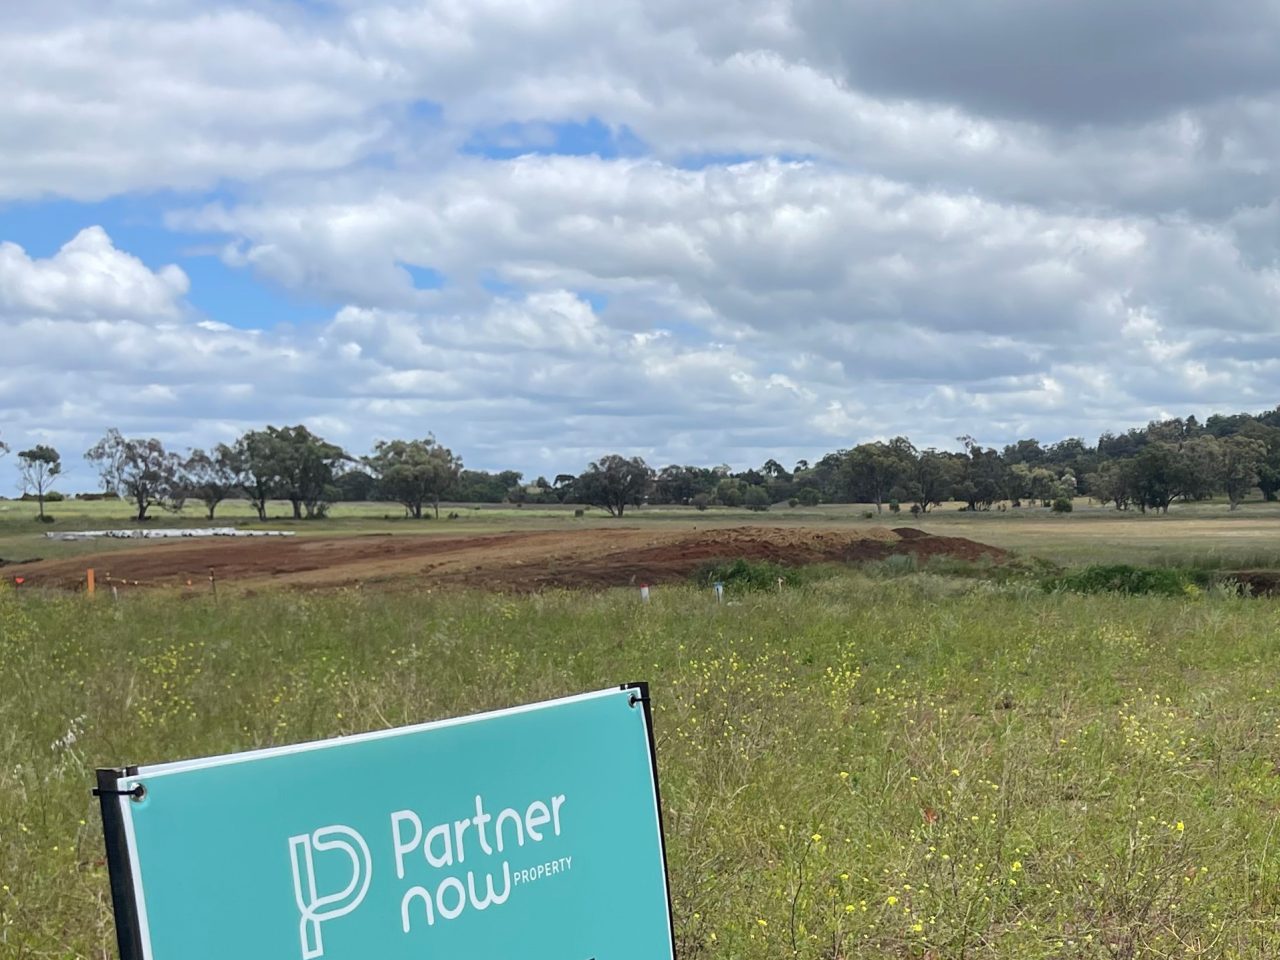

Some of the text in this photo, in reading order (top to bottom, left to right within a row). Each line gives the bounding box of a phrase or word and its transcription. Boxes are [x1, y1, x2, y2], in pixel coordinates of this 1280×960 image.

[390, 794, 566, 880] Partner
[401, 856, 573, 933] now PROPERTY
